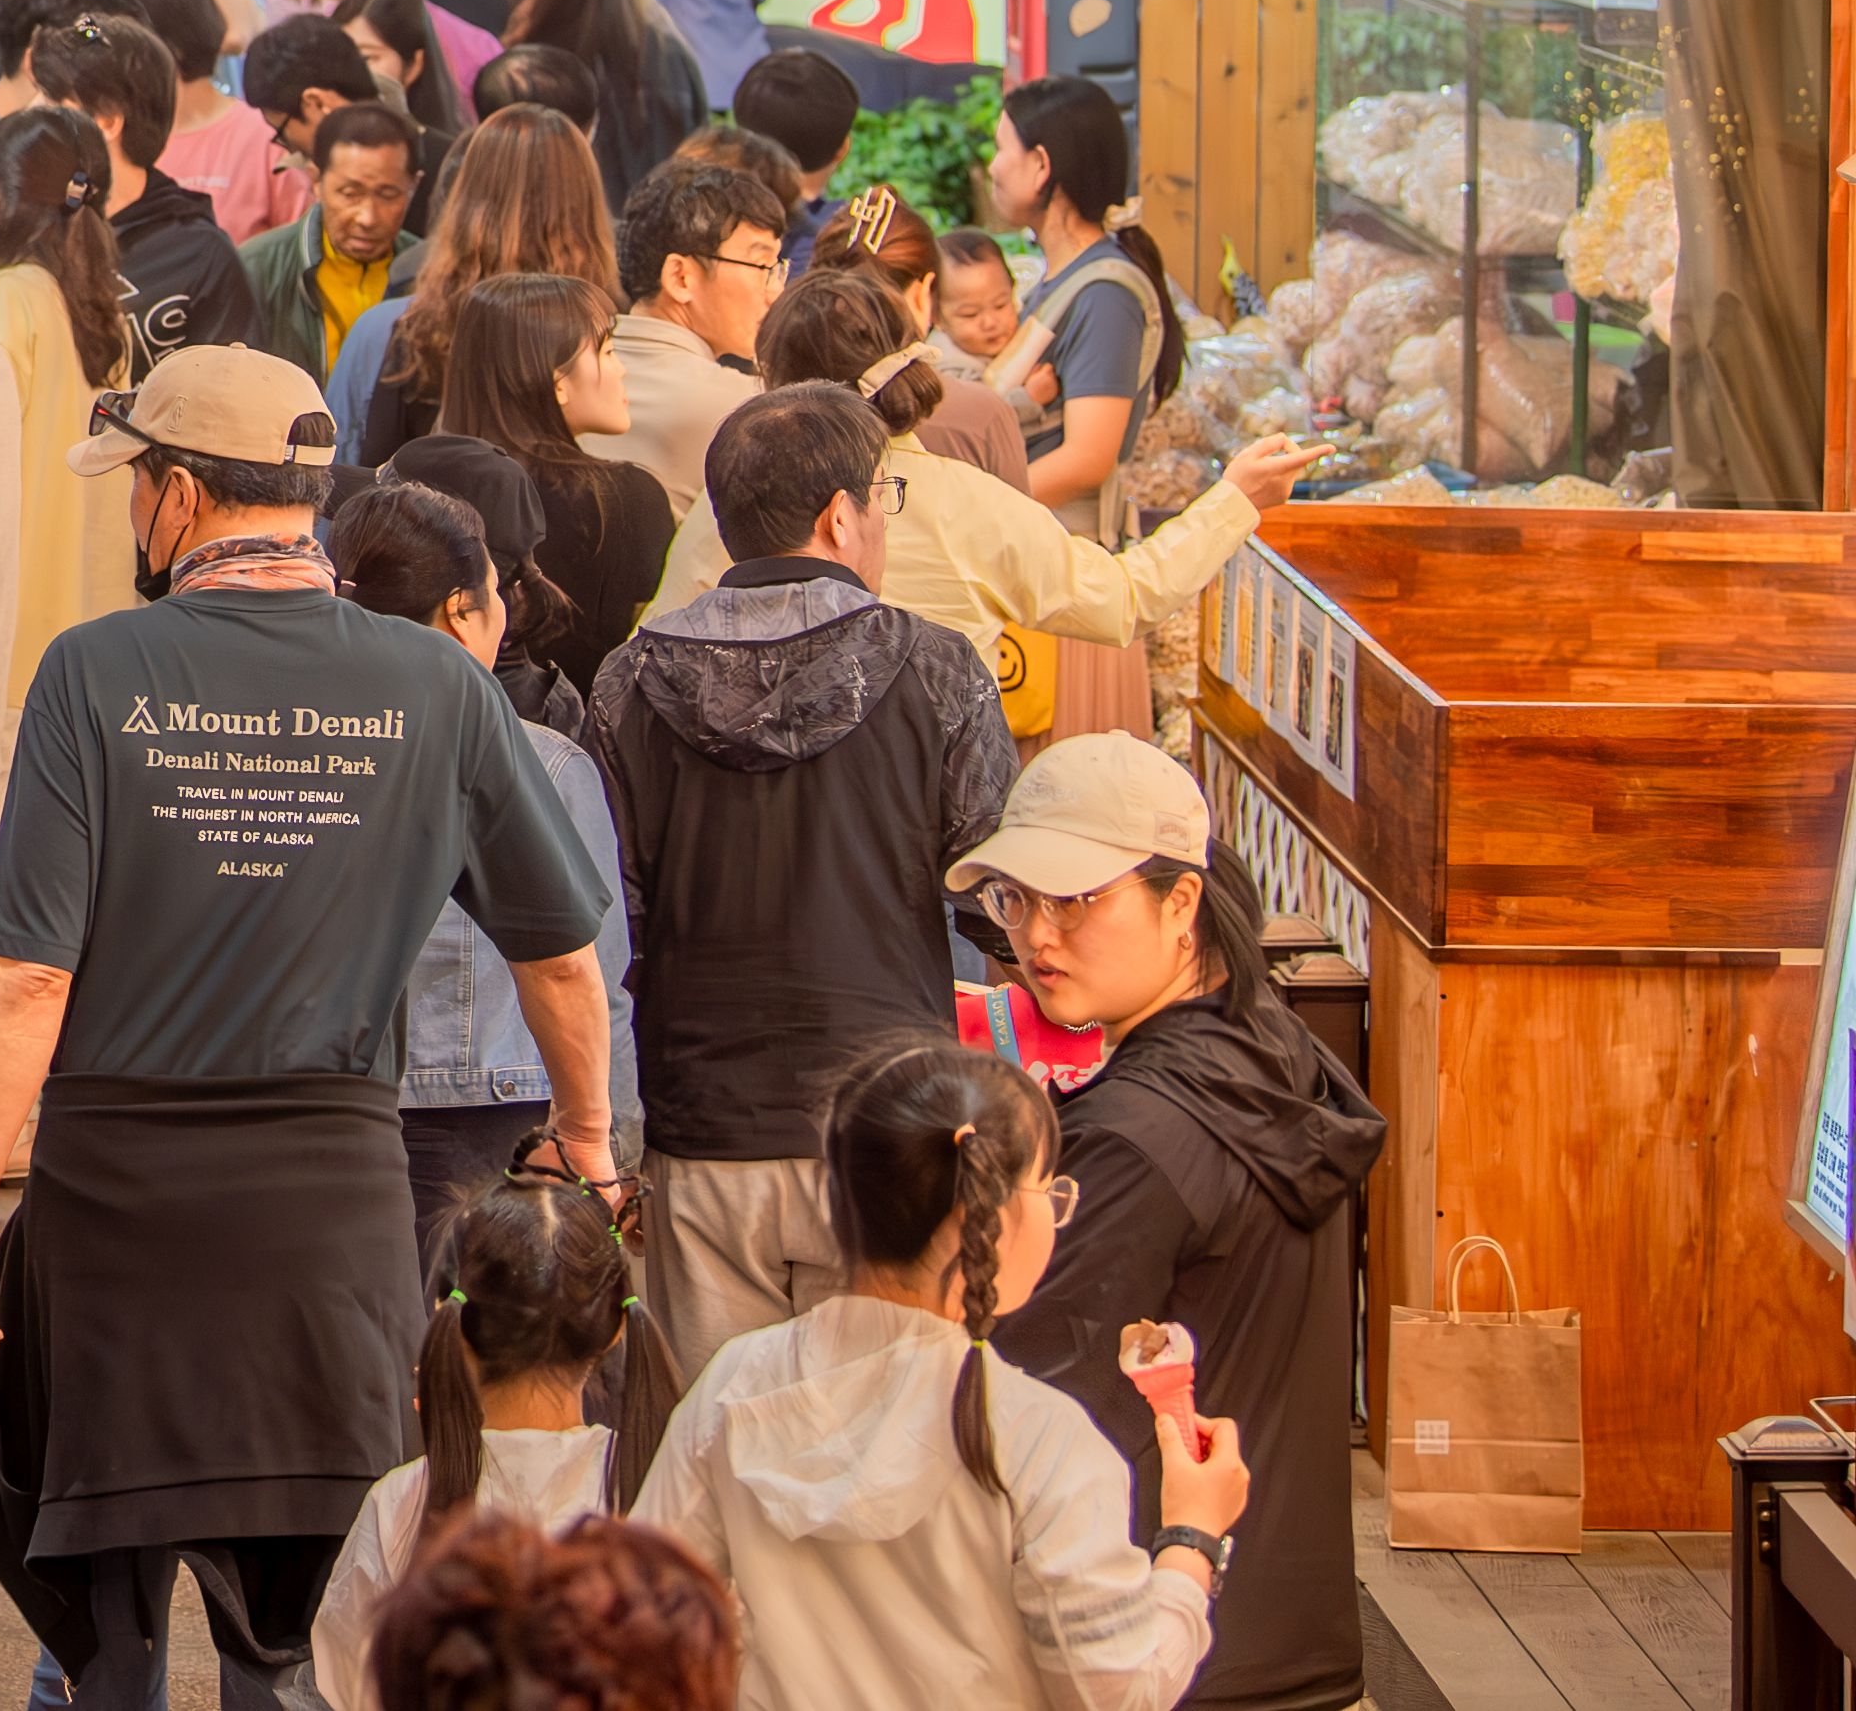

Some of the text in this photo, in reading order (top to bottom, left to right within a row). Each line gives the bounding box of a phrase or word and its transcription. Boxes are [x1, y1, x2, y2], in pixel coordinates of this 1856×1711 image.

[166, 702, 405, 740] Mount Denali
[145, 748, 377, 776] Denali National Park
[177, 786, 345, 804] TRAVEL IN MOUNT DENALI
[151, 806, 361, 826] THE HIGHEST IN NORTH AMERICA
[198, 830, 314, 845] STATE OF ALASKA
[217, 861, 284, 878] ALASKA
